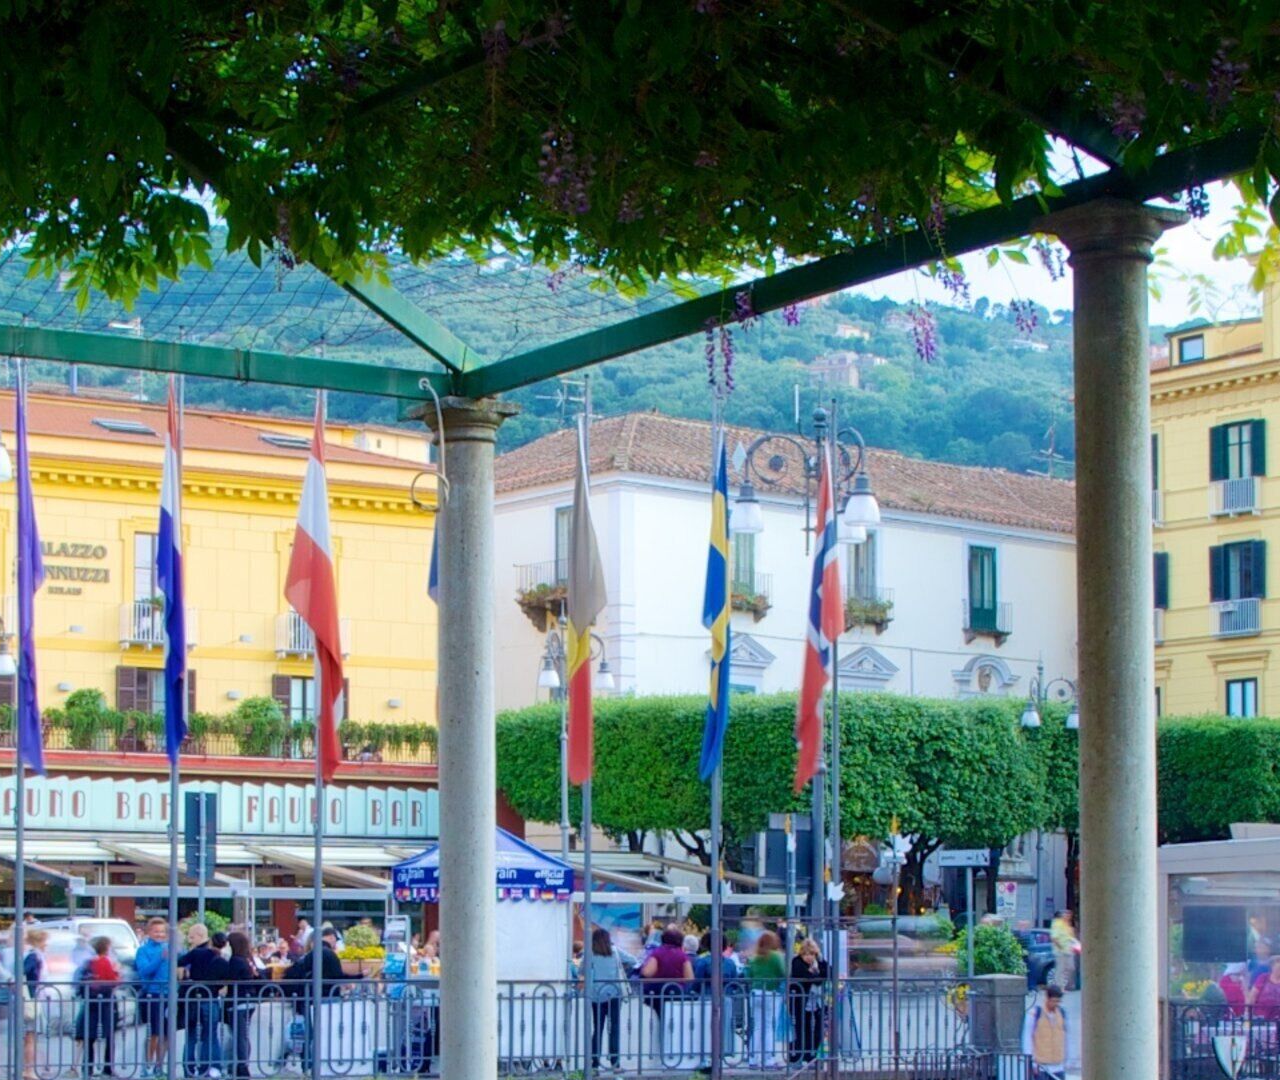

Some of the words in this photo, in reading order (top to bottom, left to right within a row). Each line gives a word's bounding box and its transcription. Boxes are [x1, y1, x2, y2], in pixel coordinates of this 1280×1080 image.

[40, 541, 108, 560] LAZZO
[44, 565, 110, 583] NNUZZI
[371, 799, 423, 827] BAR
